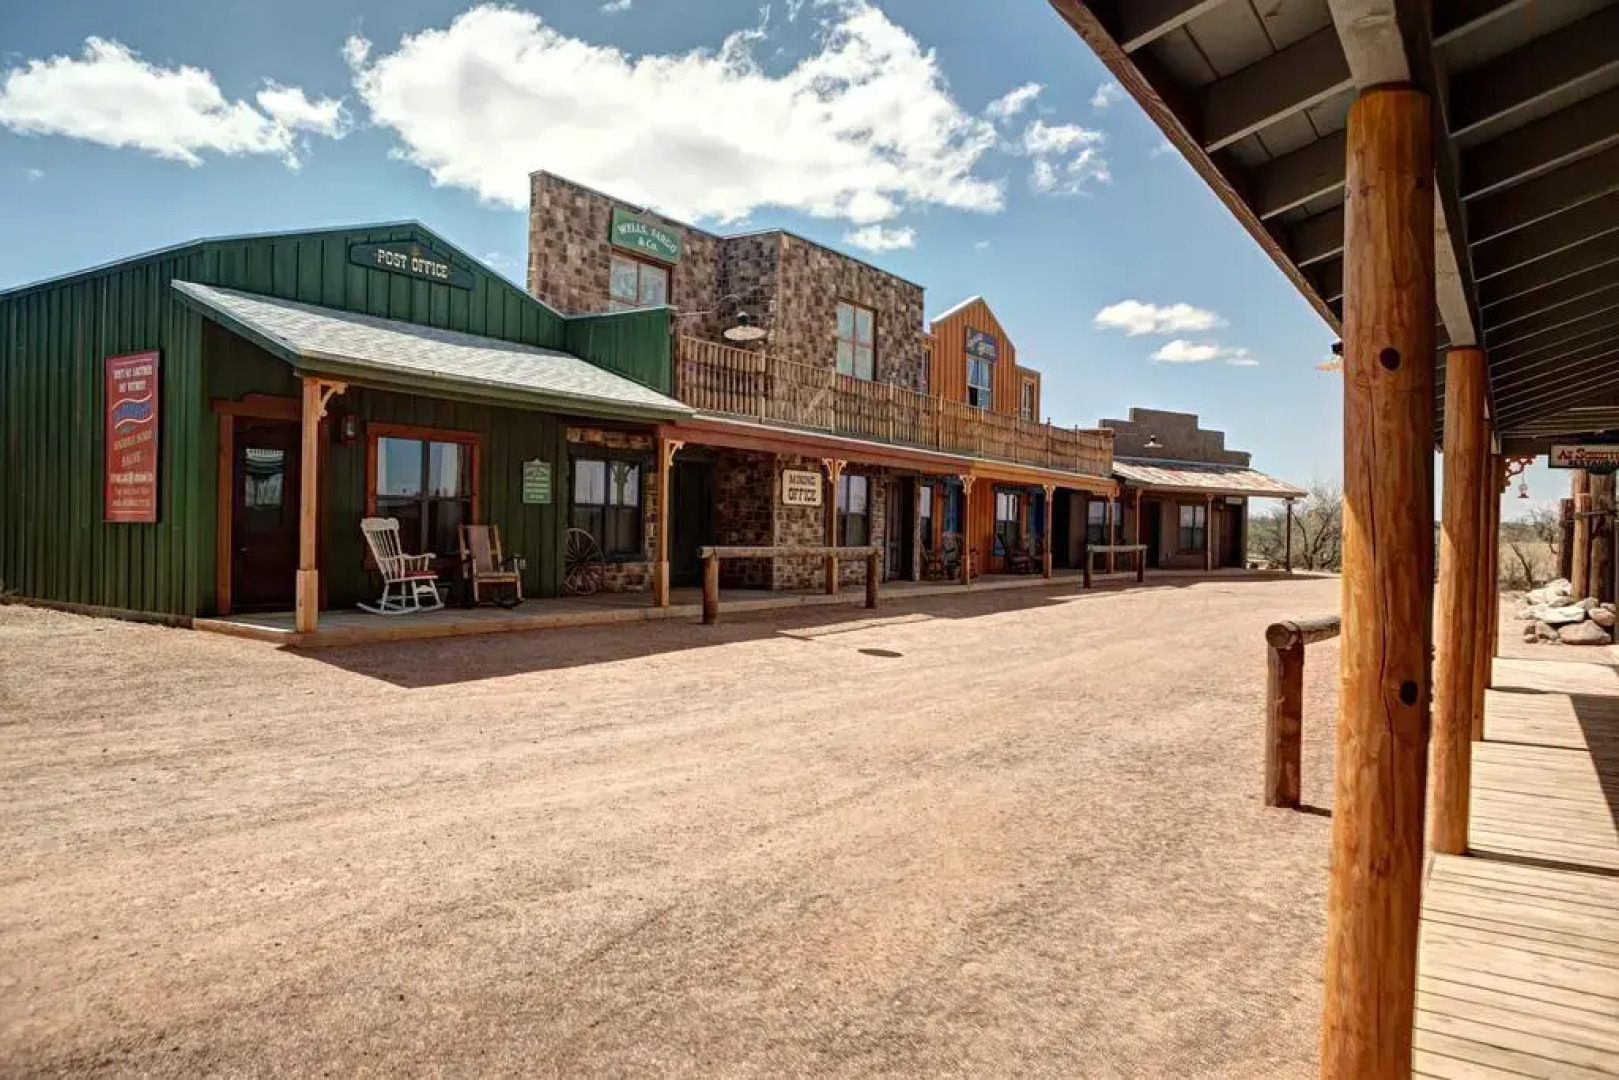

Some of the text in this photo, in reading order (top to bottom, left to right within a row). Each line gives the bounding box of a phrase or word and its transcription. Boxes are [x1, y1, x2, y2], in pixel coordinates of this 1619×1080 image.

[617, 222, 677, 254] WELLS FARGO
[377, 248, 449, 279] POST OFFICE
[789, 473, 815, 485] MINING
[789, 486, 816, 501] OFFICE
